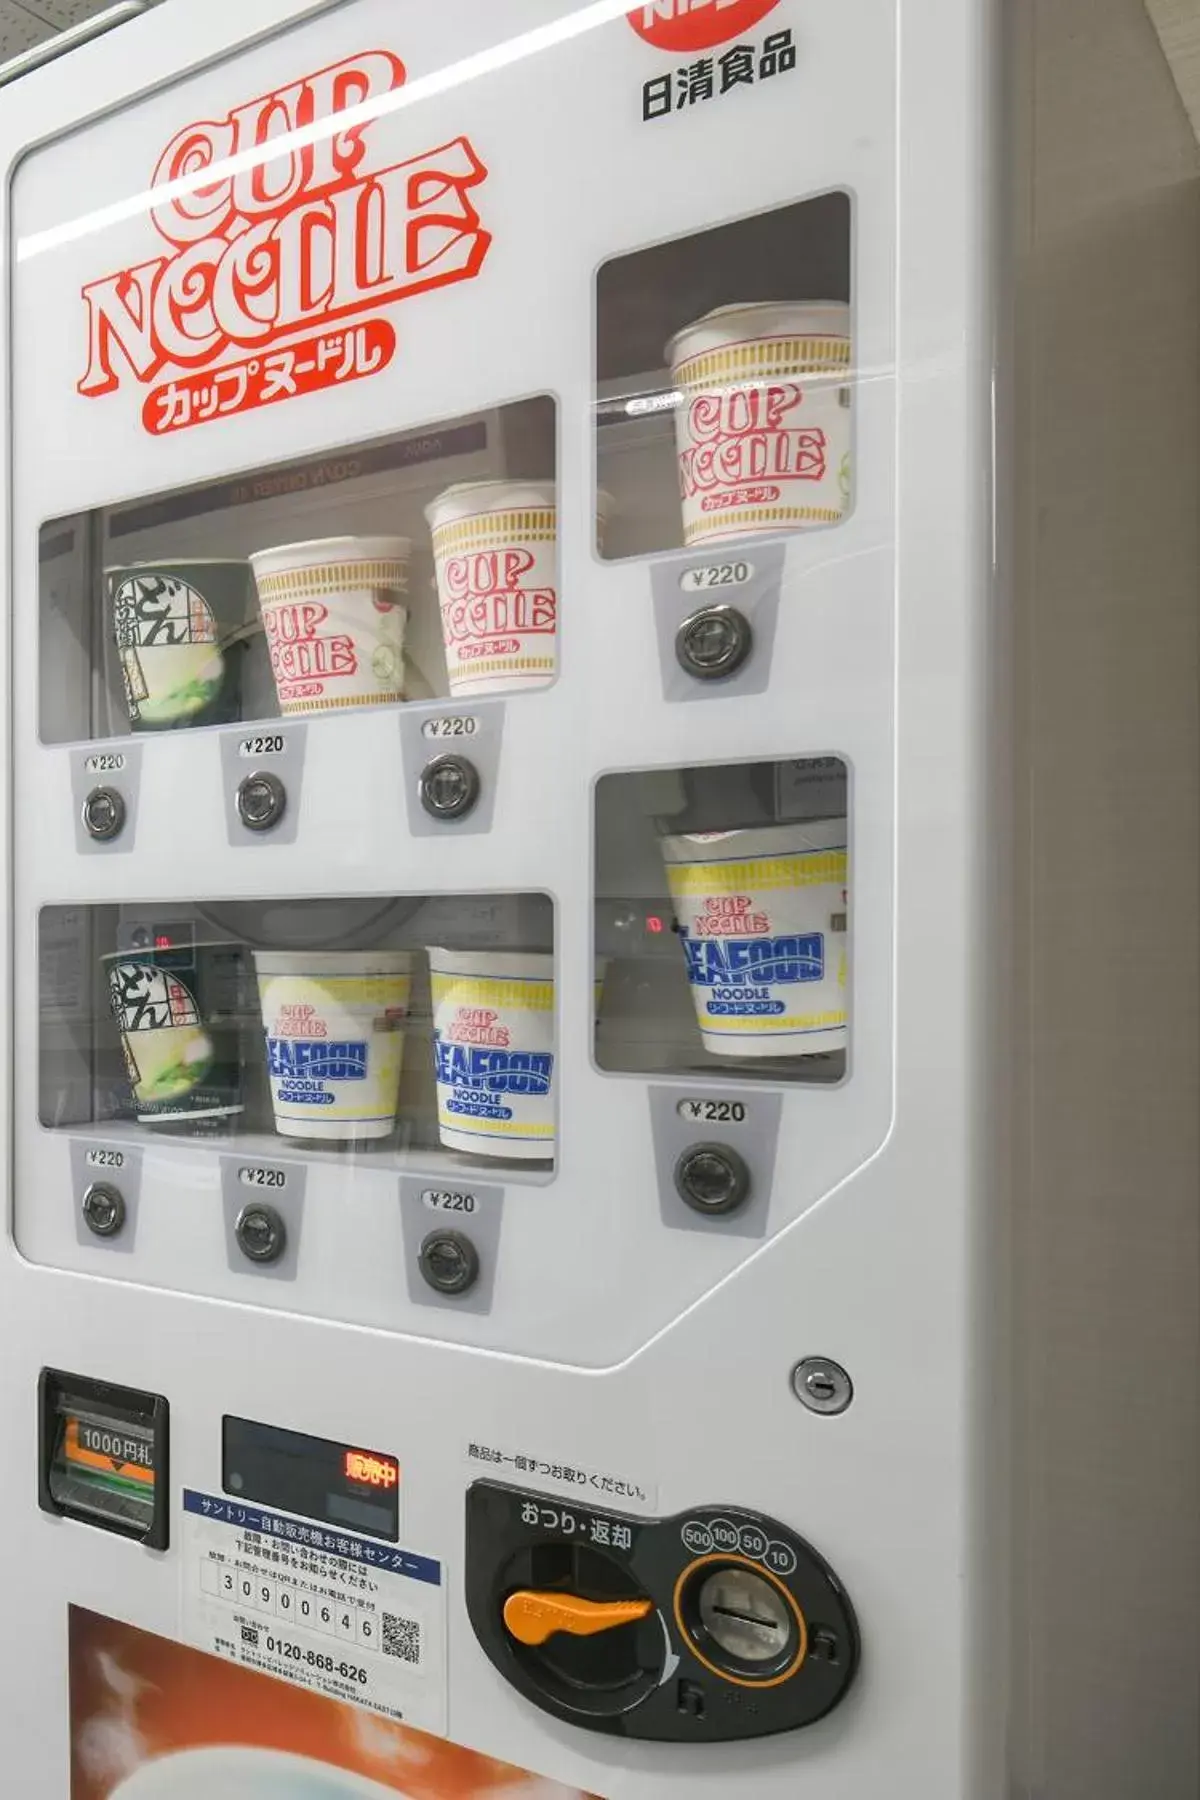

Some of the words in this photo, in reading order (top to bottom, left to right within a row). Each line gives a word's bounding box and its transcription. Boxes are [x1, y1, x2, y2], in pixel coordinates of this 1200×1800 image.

[643, 29, 796, 121] 日清食品
[150, 50, 407, 247] CUP
[77, 136, 492, 397] NOODLE
[155, 325, 382, 431] カップヌードル
[689, 384, 801, 443] CUP
[445, 547, 535, 601] CUP
[692, 562, 748, 587] ¥220
[244, 736, 284, 755] ¥220
[429, 717, 475, 737] ¥220
[90, 754, 124, 771] ¥220
[703, 895, 752, 915] CUP
[681, 932, 824, 987] EAFOOD
[712, 988, 770, 1000] NOODLE
[267, 1037, 369, 1080] EAFOOD
[435, 1041, 554, 1095] EAFOOD
[281, 1080, 325, 1092] NOODLE
[453, 1089, 502, 1105] NOODLE
[689, 1101, 745, 1122] ¥220
[89, 1150, 124, 1168] ¥220
[247, 1168, 285, 1187] ¥220
[429, 1191, 475, 1213] ¥220
[84, 1429, 153, 1466] 1000円札
[467, 1442, 647, 1502] 商品は一個ずつお取りください。
[200, 1497, 420, 1571] サントリー自動販売機お客様センター
[520, 1502, 632, 1551] おつり・返却
[686, 1529, 711, 1548] 500
[713, 1524, 738, 1542] 100
[742, 1535, 763, 1551] 50
[770, 1551, 789, 1567] 10
[266, 1636, 368, 1685] 0120-868-626
